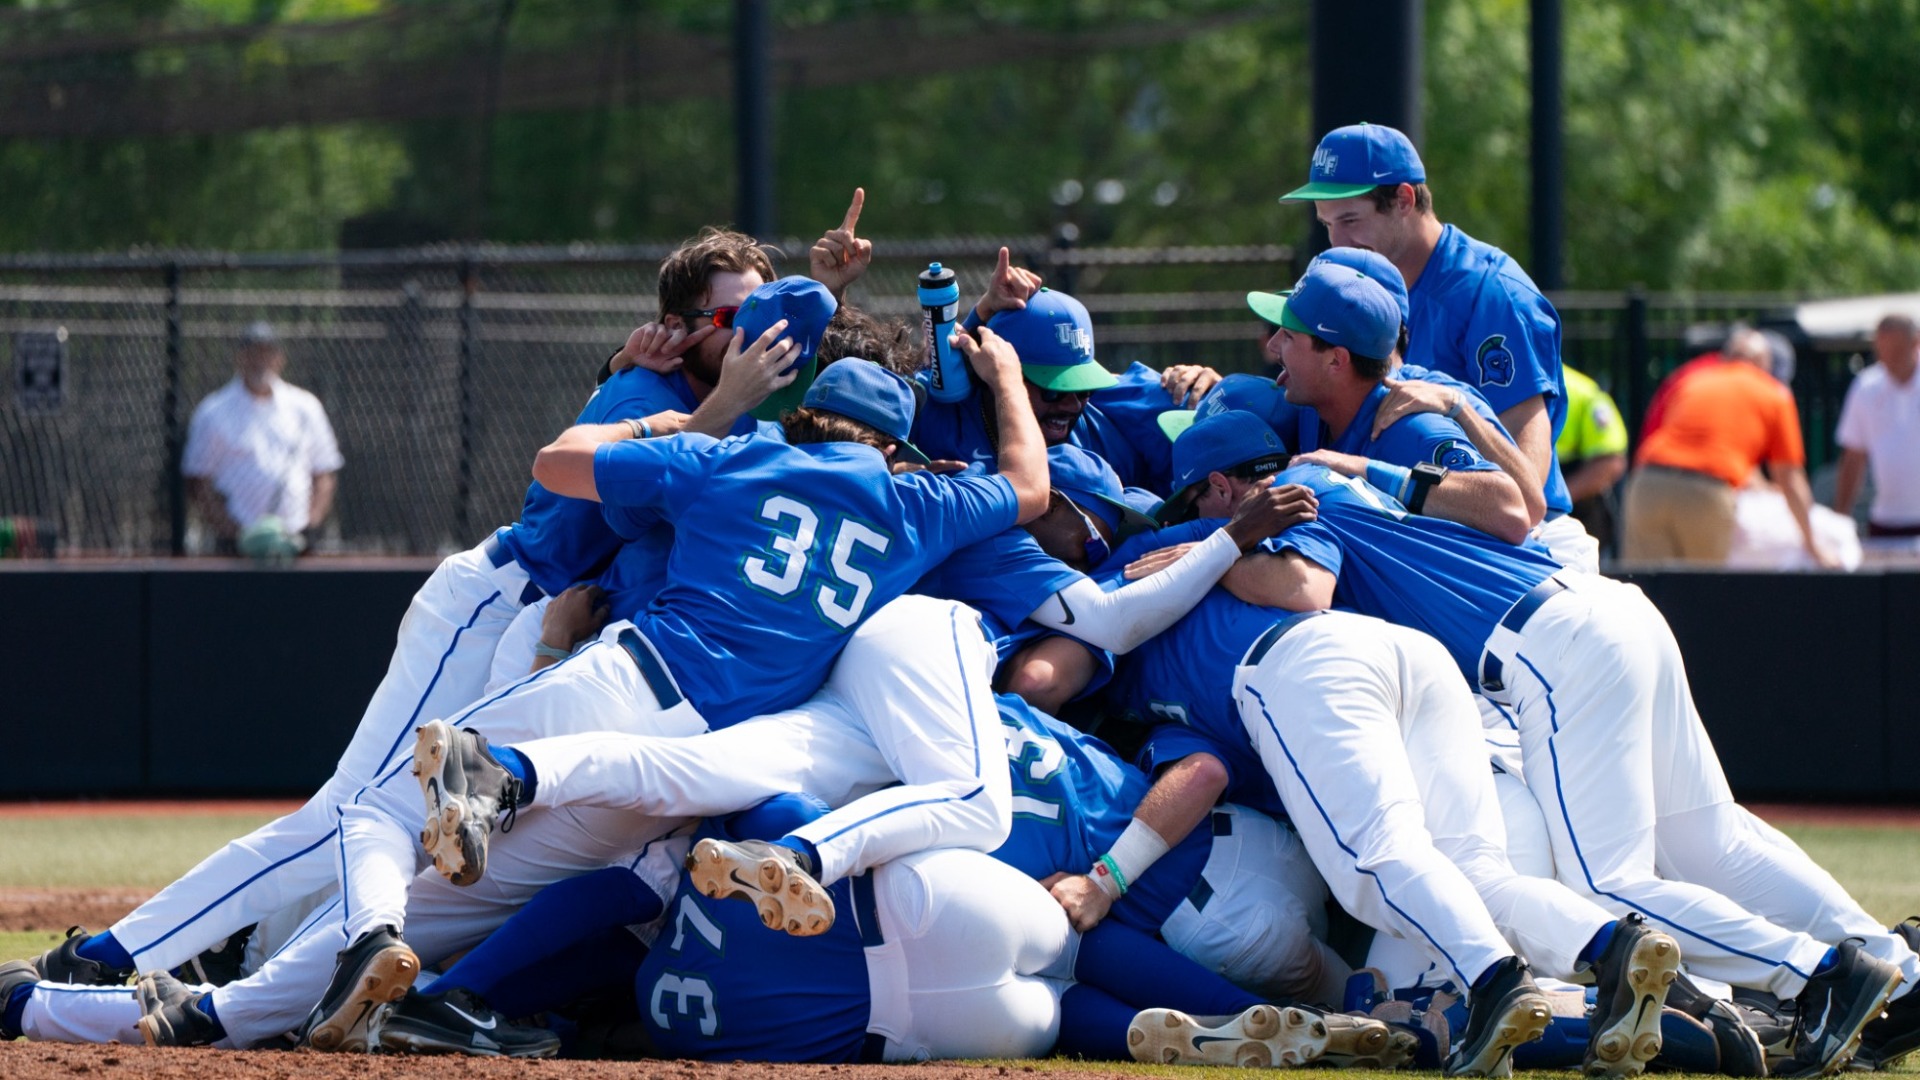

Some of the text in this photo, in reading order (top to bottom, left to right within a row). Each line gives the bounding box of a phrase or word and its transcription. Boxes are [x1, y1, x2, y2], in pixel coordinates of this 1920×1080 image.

[922, 307, 943, 388] POWERADE
[1054, 322, 1091, 357] UWF
[1254, 461, 1278, 472] SMITH
[743, 494, 890, 629] 35
[650, 893, 723, 1037] 37
